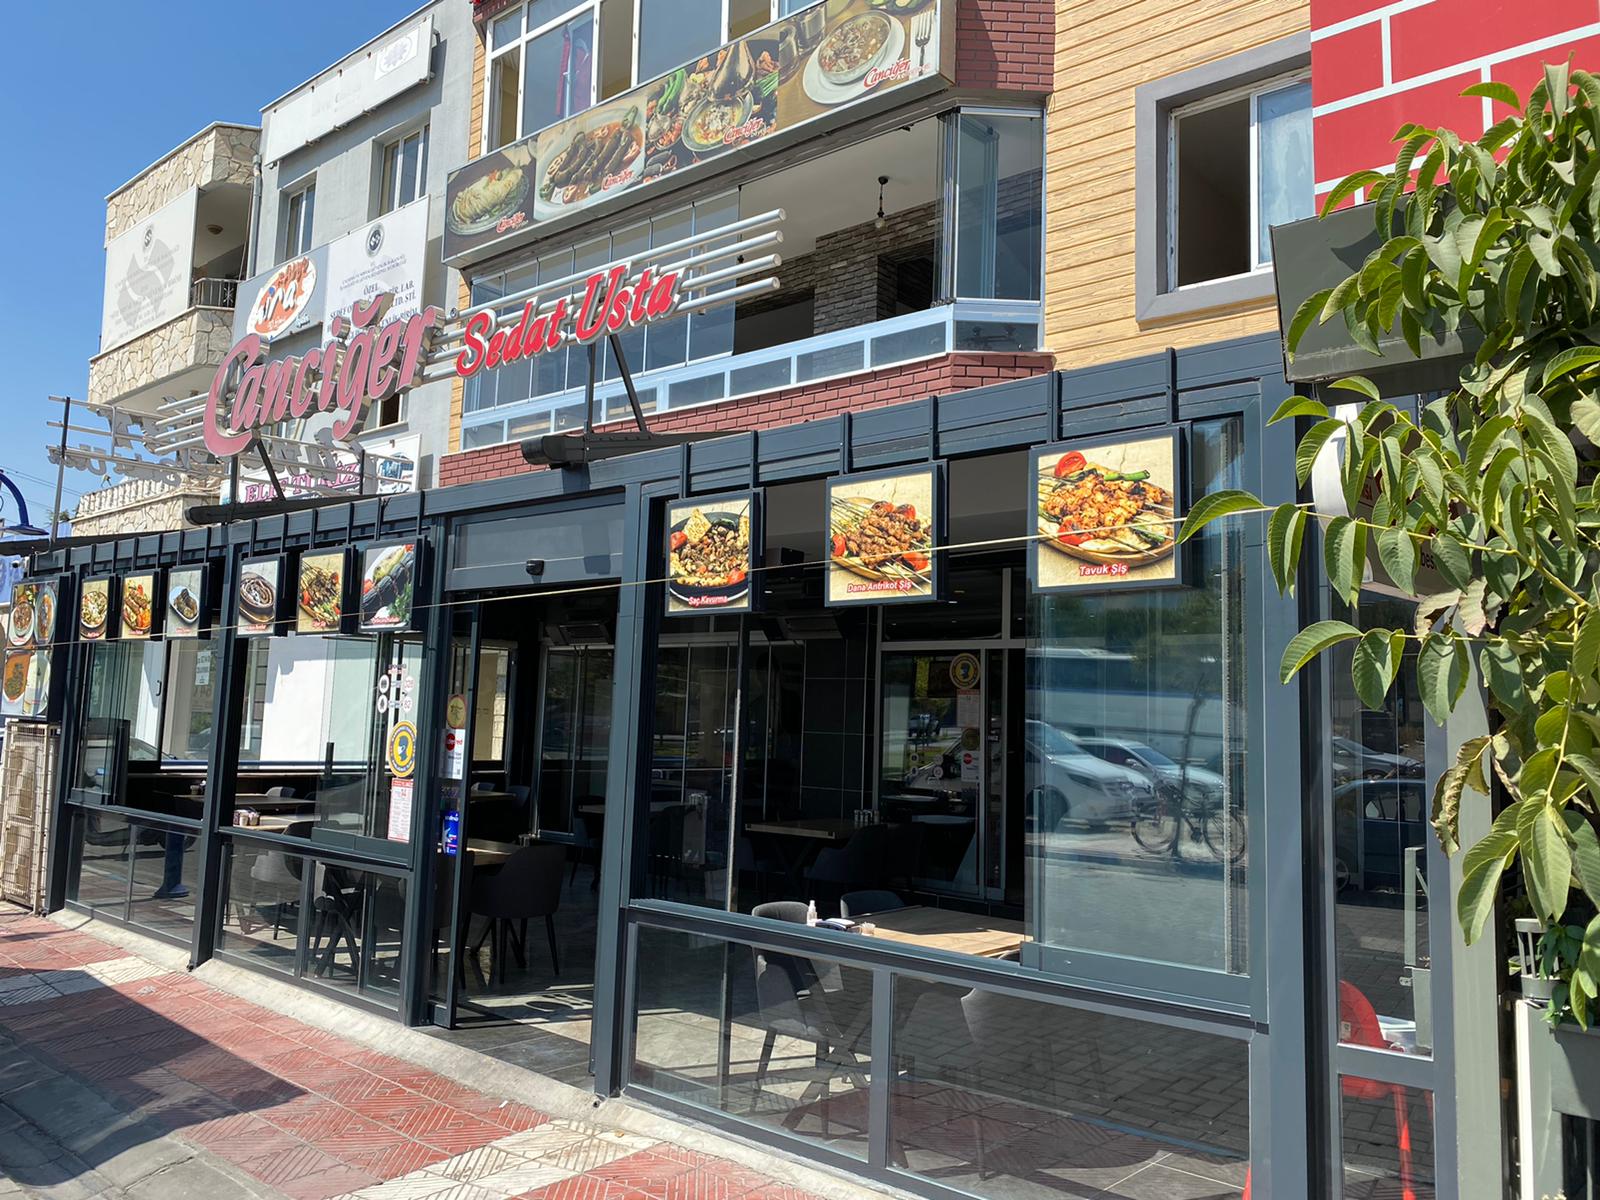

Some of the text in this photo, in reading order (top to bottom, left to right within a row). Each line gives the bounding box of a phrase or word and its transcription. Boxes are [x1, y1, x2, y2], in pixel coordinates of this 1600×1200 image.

[456, 262, 684, 378] Sedat Usta
[203, 292, 442, 457] Canciğer
[847, 582, 866, 593] Dana
[867, 580, 897, 591] Antrikot
[1079, 562, 1128, 576] Tavuk Şiş
